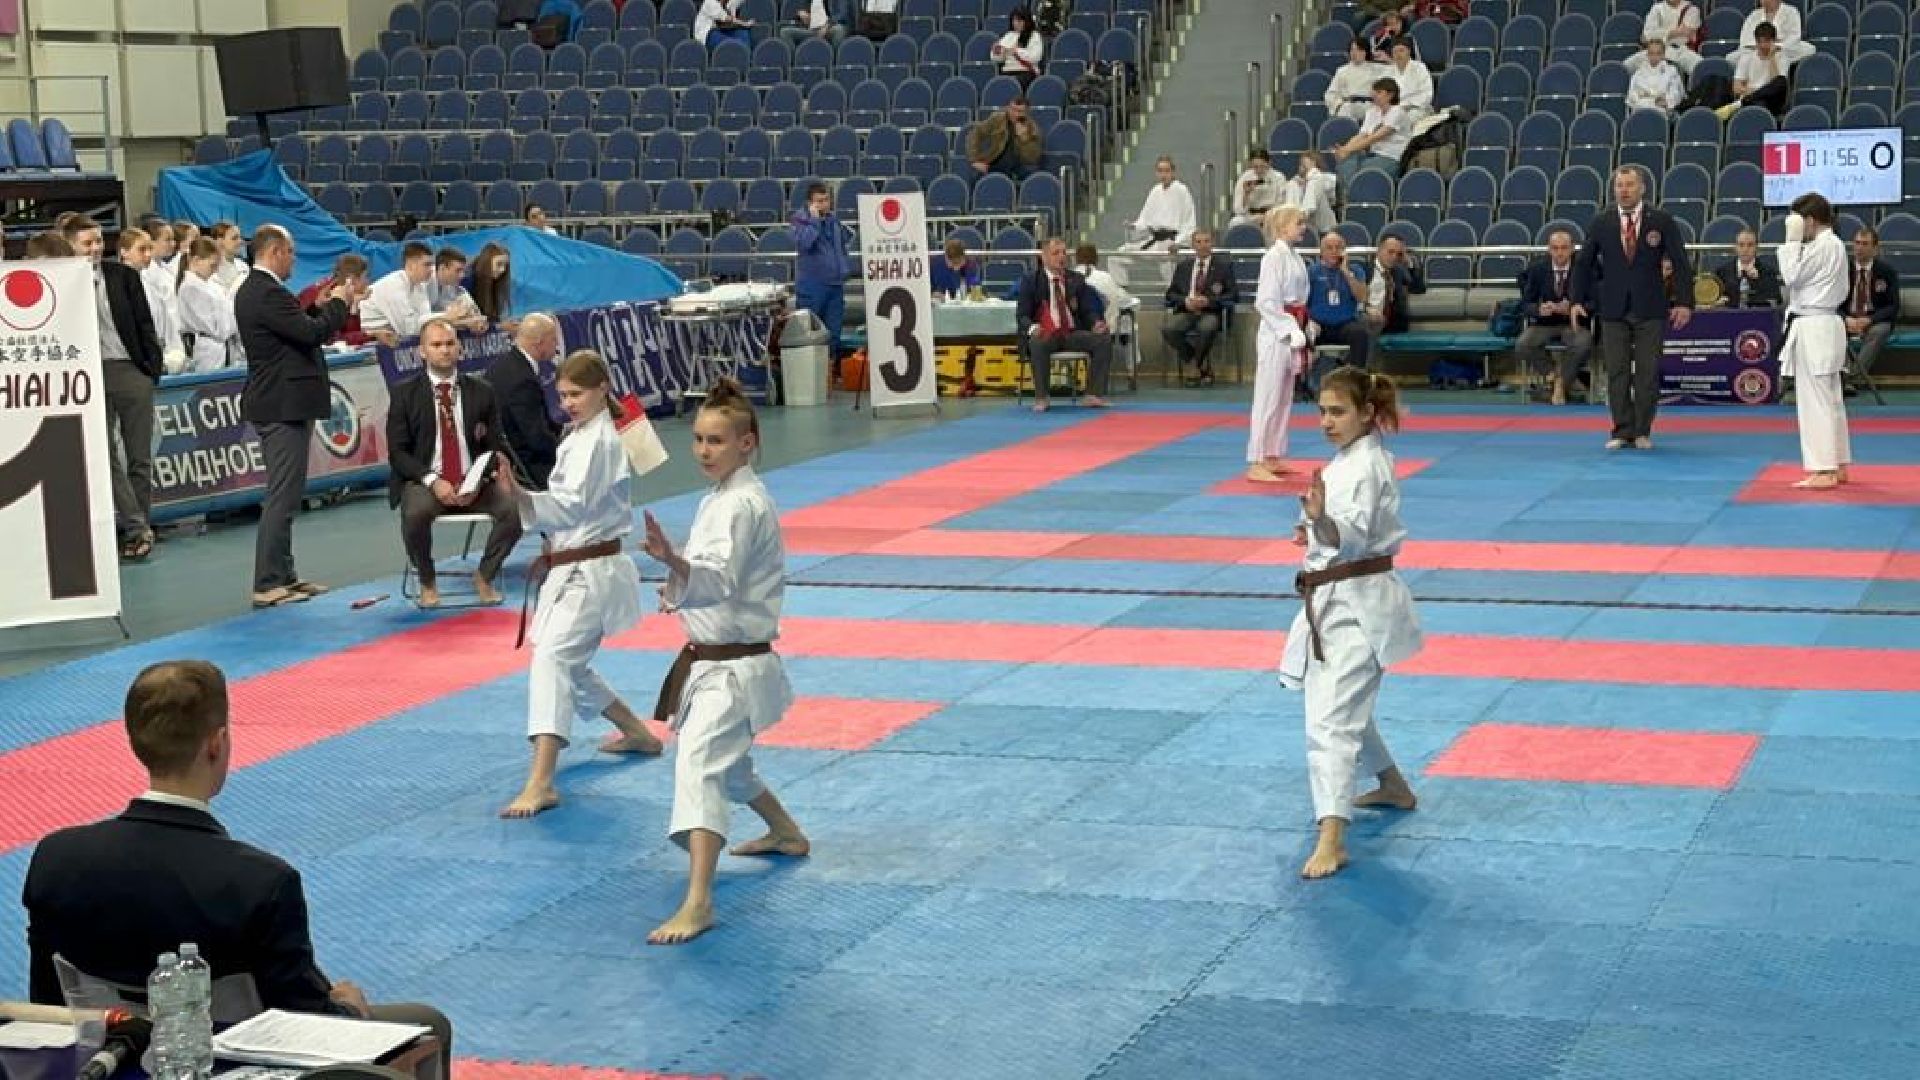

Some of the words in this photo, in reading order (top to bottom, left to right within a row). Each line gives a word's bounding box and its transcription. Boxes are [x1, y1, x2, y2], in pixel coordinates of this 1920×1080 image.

[1774, 145, 1787, 173] 1
[1806, 147, 1859, 167] 01:56
[867, 257, 904, 281] SHIAI
[907, 257, 923, 280] JO
[875, 286, 923, 393] 3
[0, 372, 51, 409] HIAI
[58, 369, 92, 406] JO
[155, 403, 198, 438] ЕЦ
[0, 414, 98, 600] 1
